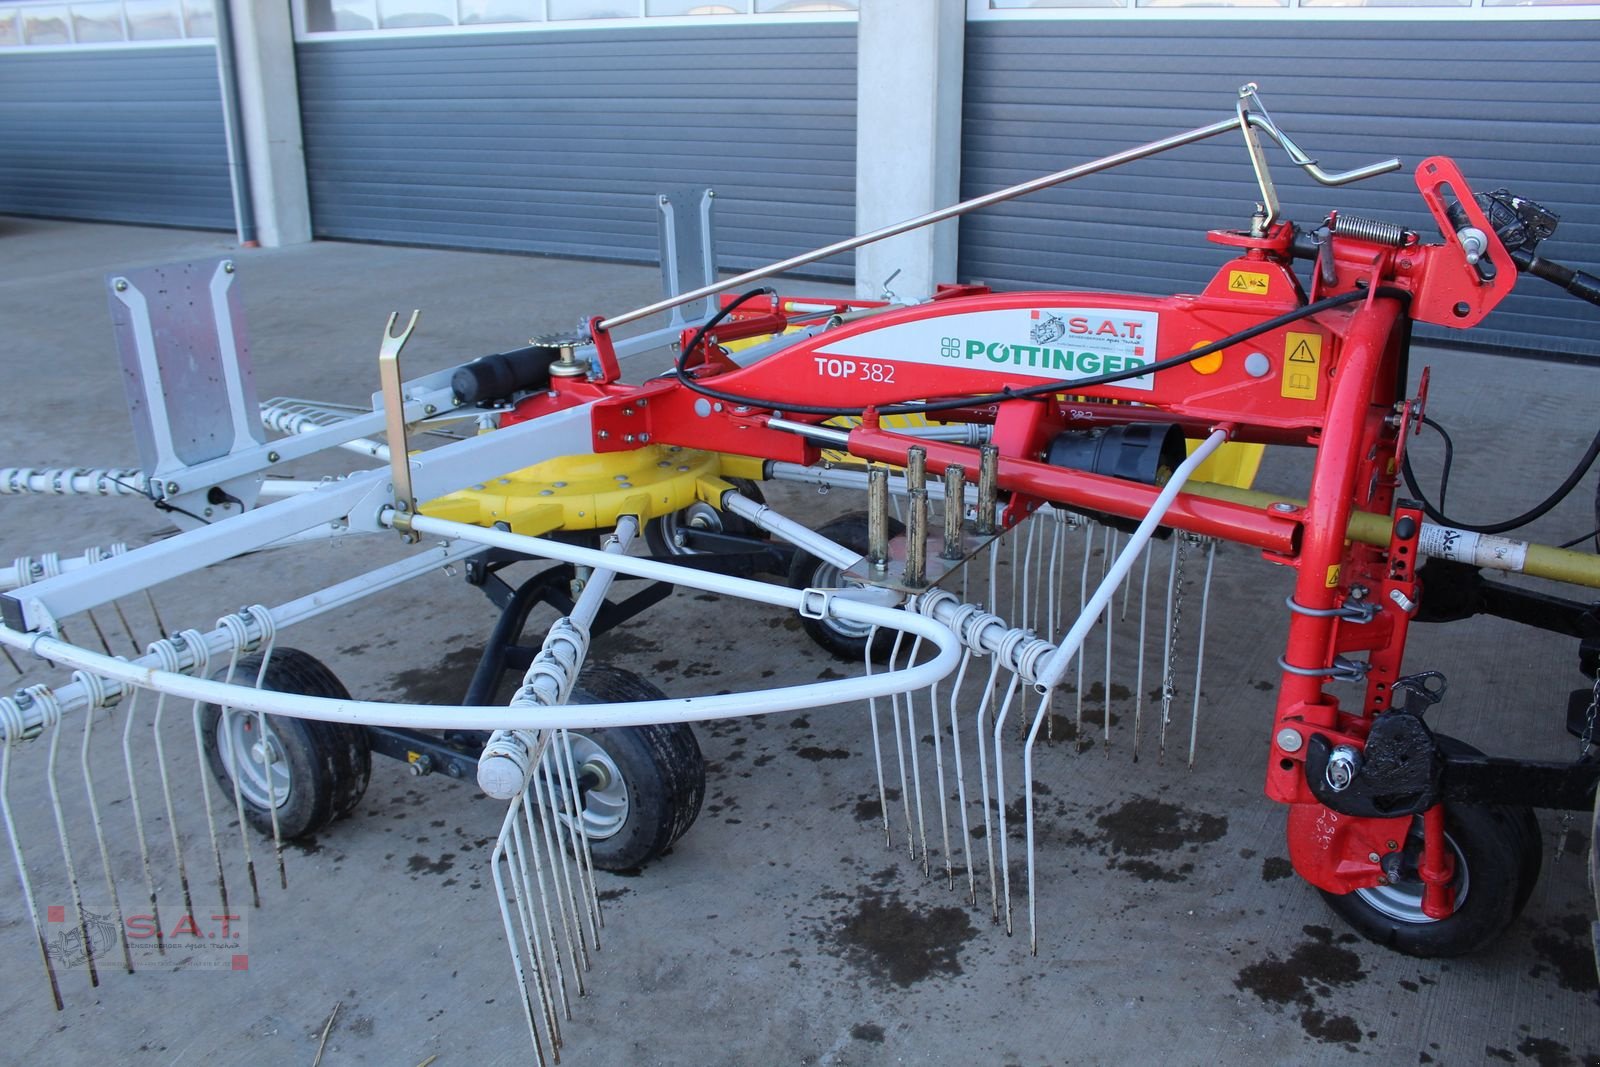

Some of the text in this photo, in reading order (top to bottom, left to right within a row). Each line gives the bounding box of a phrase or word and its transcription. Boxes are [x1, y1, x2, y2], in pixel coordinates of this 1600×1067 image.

[1068, 317, 1143, 339] S.A.T.
[814, 357, 895, 384] TOP 382
